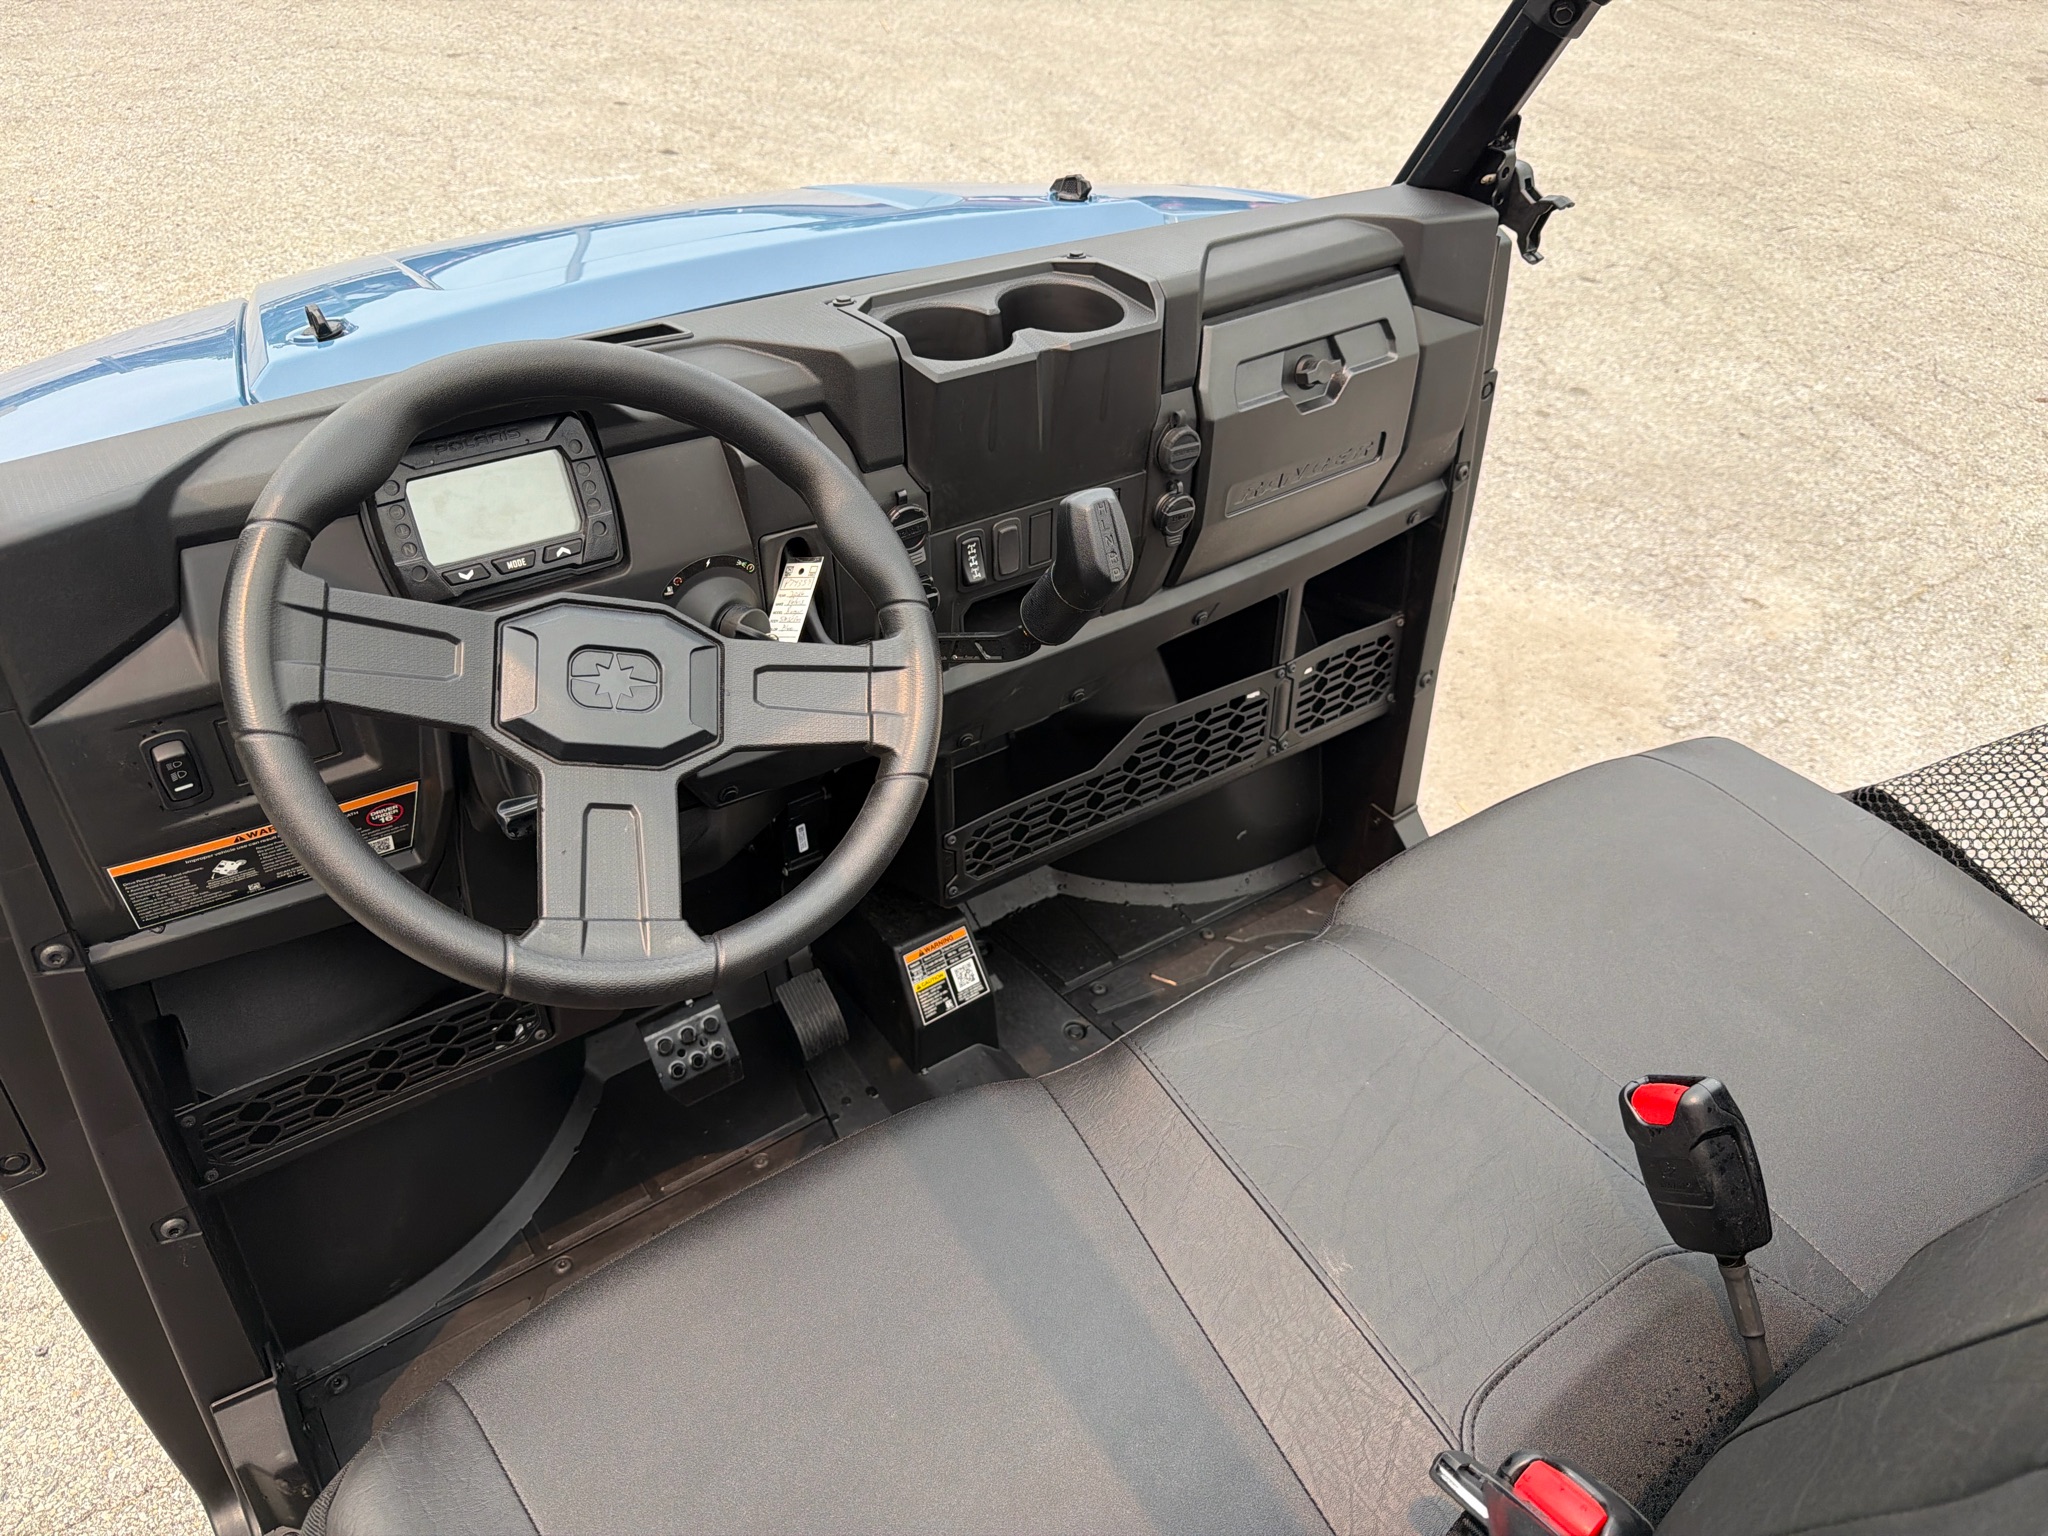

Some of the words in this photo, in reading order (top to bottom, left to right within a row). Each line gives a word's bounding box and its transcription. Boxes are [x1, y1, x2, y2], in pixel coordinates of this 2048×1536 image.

[435, 427, 521, 456] POLARIS
[506, 557, 527, 570] MODE
[370, 805, 399, 817] DRIVER
[371, 809, 399, 820] UNDER
[379, 815, 394, 824] 16
[185, 854, 214, 865] Improper
[215, 847, 236, 857] vehicle
[923, 934, 954, 953] WARNING
[921, 973, 945, 988] CAUTION
